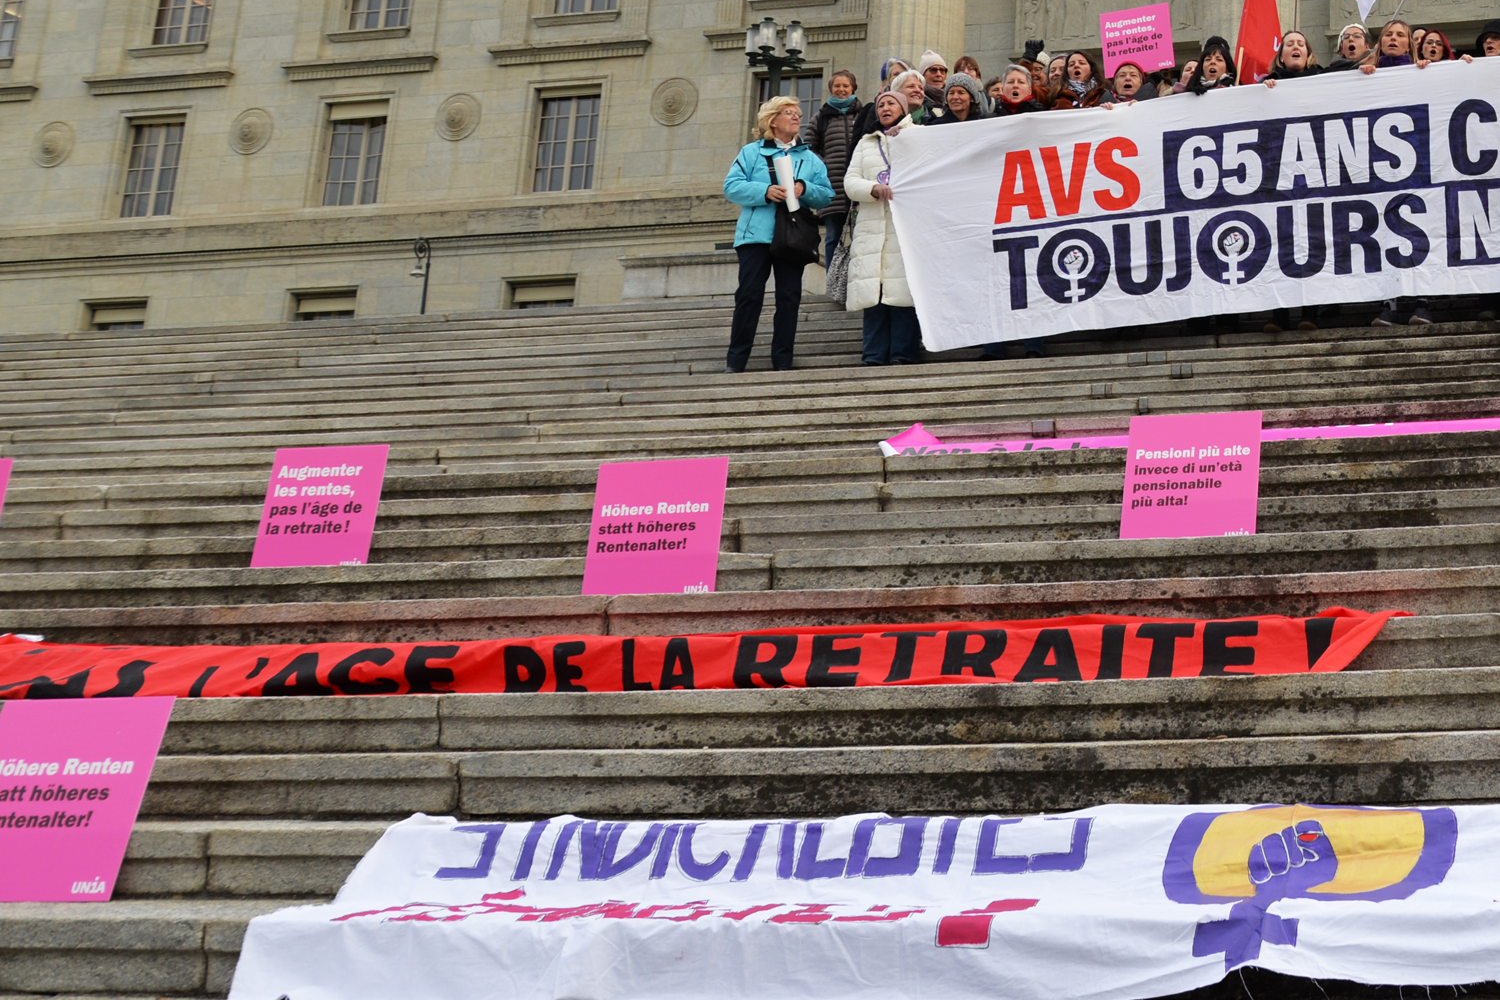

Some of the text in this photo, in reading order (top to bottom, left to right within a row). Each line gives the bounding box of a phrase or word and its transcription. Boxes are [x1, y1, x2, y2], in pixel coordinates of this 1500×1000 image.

[1105, 14, 1156, 29] Augmenter
[1105, 25, 1156, 39] les rentes,
[1106, 38, 1124, 49] pas
[1151, 32, 1163, 41] de
[994, 136, 1141, 225] AVS
[1177, 128, 1263, 200] 65
[1276, 111, 1418, 191] ANS
[993, 192, 1431, 311] TOUJOURS
[1135, 444, 1251, 460] Pensioni più alte
[277, 463, 363, 482] Augmenter
[1134, 464, 1179, 476] invece
[1182, 462, 1196, 474] di
[273, 482, 355, 498] les rentes,
[1132, 477, 1222, 494] pensionabile
[269, 504, 298, 519] pas
[343, 500, 363, 514] de
[601, 500, 710, 518] Höhere Renten
[1131, 494, 1189, 510] più alta!
[265, 522, 280, 536] la
[598, 519, 696, 535] statt höheres
[596, 537, 688, 554] Rentenalter!
[502, 640, 588, 694] DE
[621, 637, 694, 692] LA
[732, 620, 1259, 690] RETRAITE
[62, 757, 135, 776] Renten
[28, 783, 110, 802] höheres
